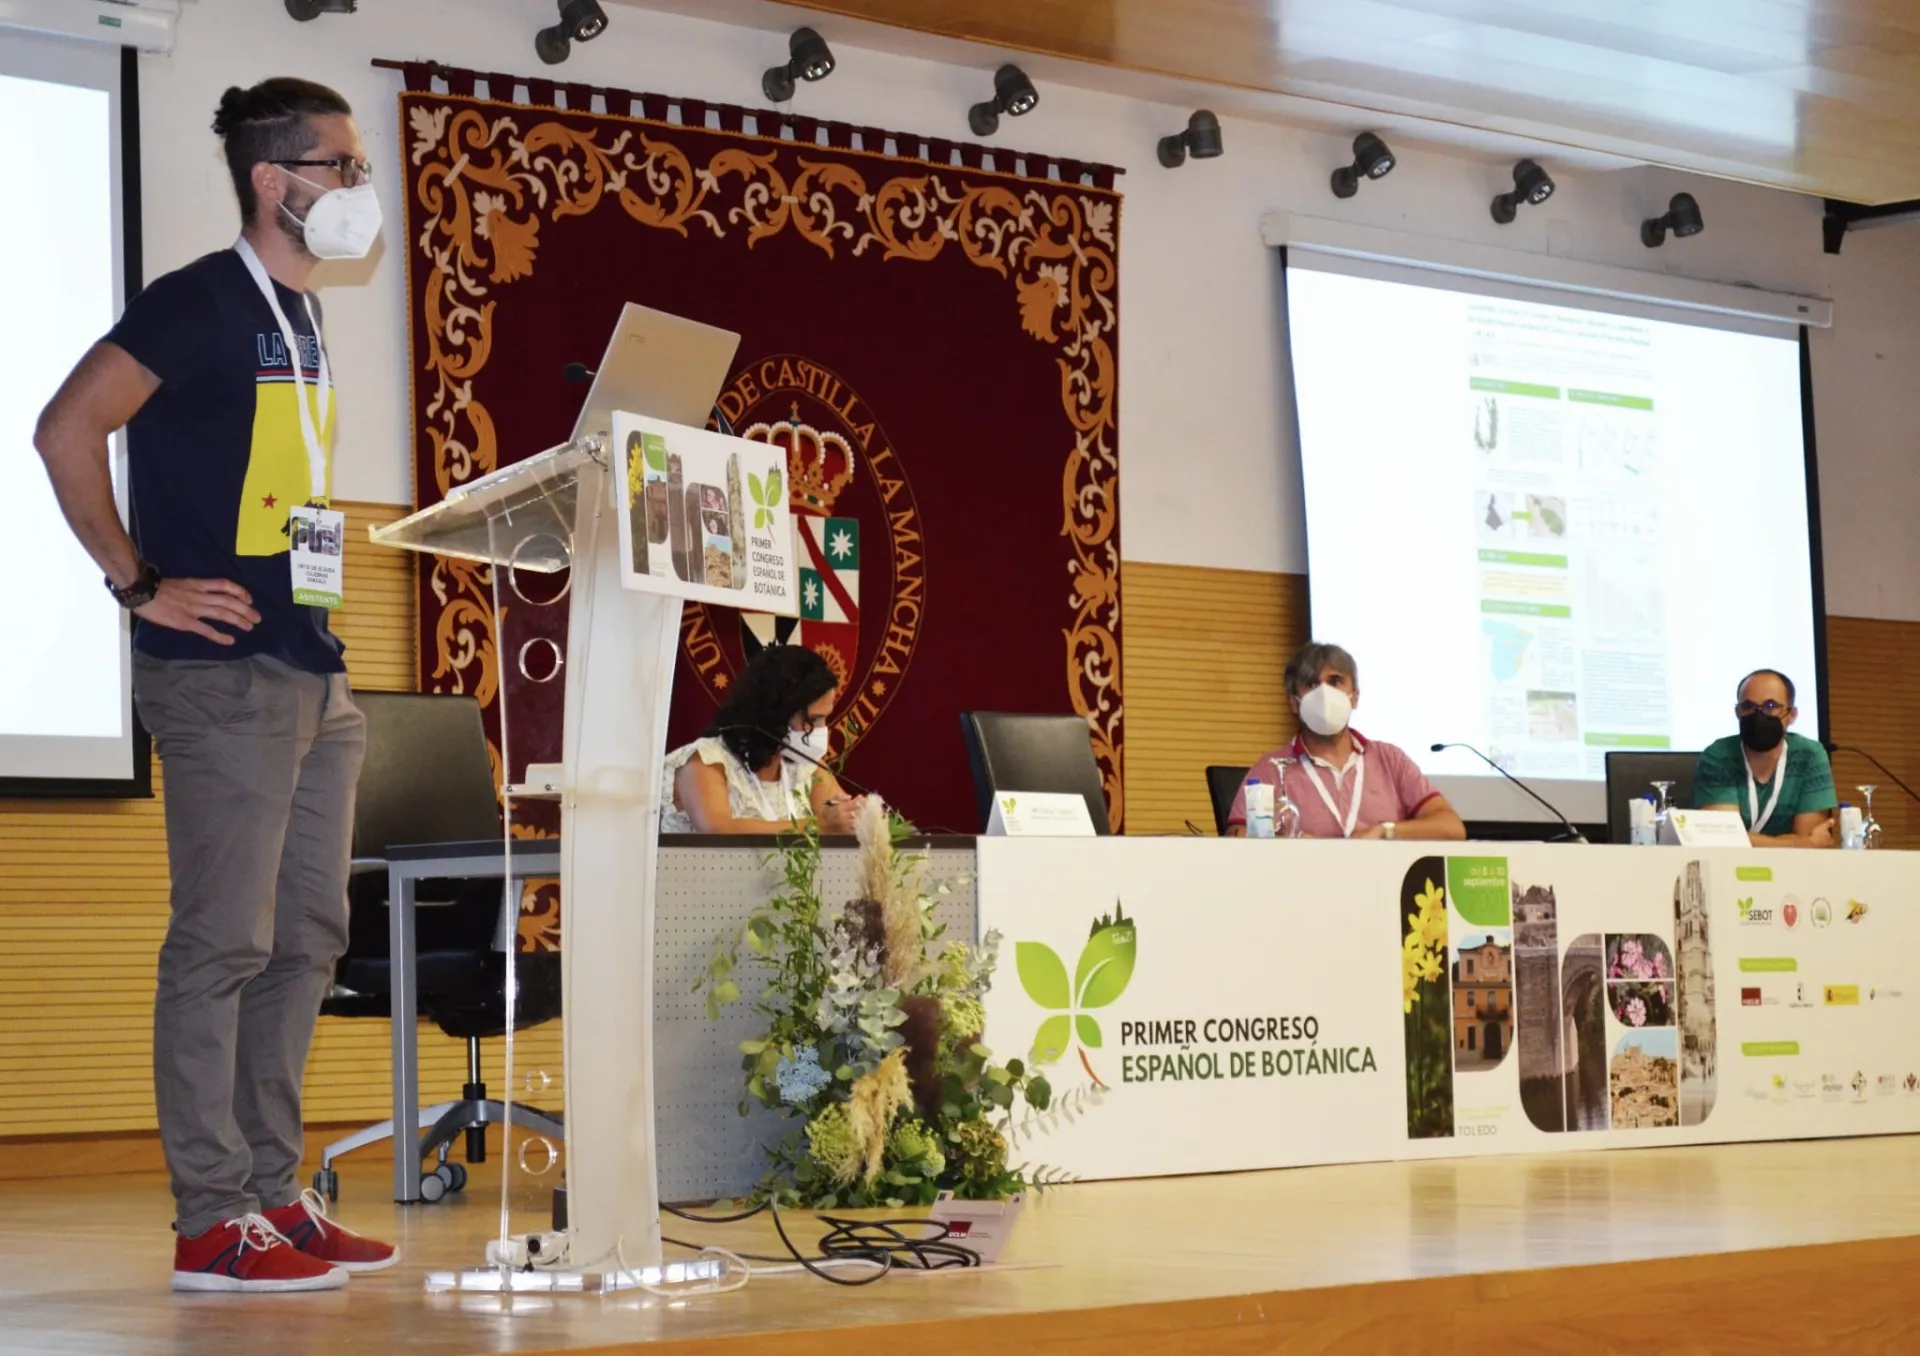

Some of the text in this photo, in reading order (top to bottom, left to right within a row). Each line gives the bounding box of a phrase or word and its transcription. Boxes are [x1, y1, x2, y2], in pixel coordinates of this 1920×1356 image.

[256, 332, 288, 367] LA
[716, 358, 923, 674] DE CASTILLA LA MANCHA
[751, 536, 772, 549] PRIMER
[752, 551, 784, 566] CONGRESO
[1748, 909, 1773, 921] SEBOT
[1121, 1015, 1319, 1046] PRIMER CONGRESO
[1122, 1039, 1378, 1083] ESPAÑOL DE BOTÁNICA
[1457, 1124, 1498, 1137] TOLEDO
